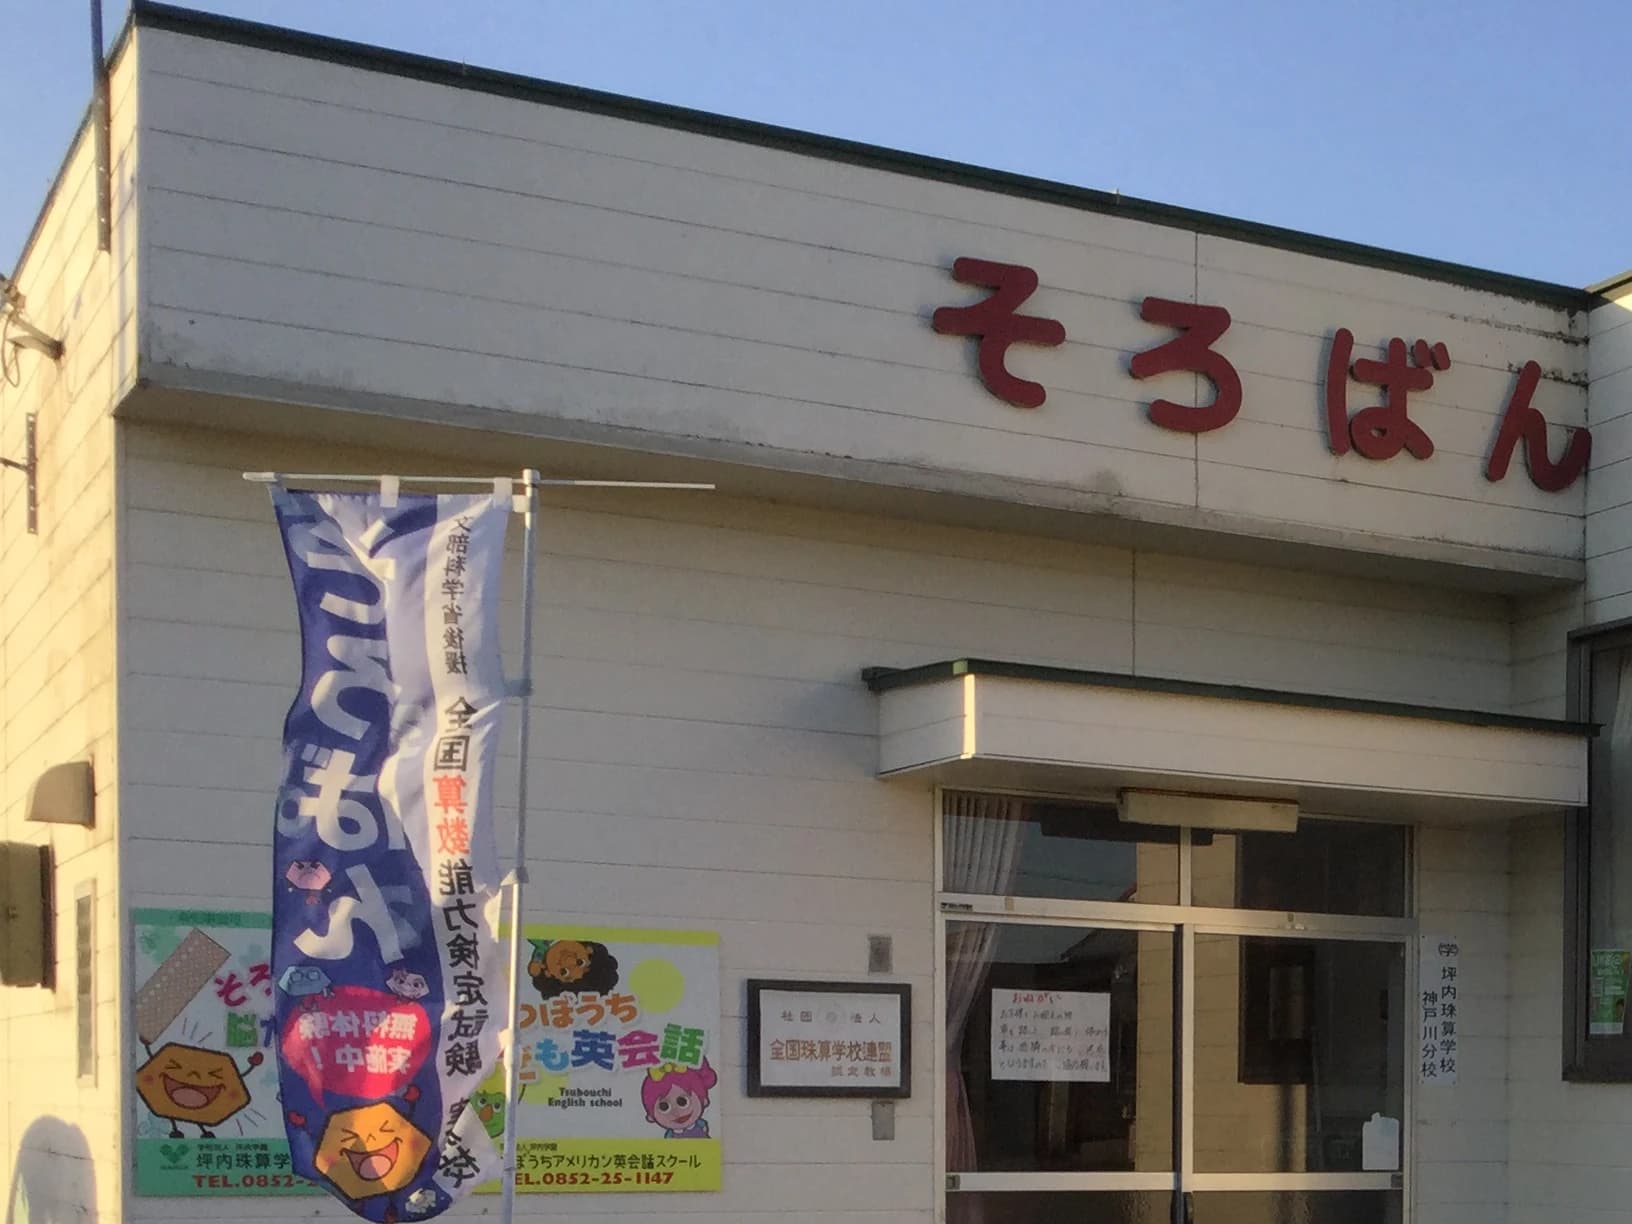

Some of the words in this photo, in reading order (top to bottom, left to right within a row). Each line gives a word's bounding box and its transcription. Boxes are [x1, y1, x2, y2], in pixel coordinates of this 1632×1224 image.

[932, 256, 1592, 492] そろばん
[519, 992, 638, 1029] つぼうち
[1440, 966, 1457, 1073] 坪内珠算学校
[1421, 991, 1438, 1077] 神戸川分校
[769, 1038, 893, 1063] 全国珠算学校連盟
[548, 1097, 586, 1109] English
[589, 1097, 623, 1108] school
[559, 1087, 612, 1097] Tsubouchi
[515, 1150, 703, 1170] ぼうちアメリカン英会話スクール
[515, 1171, 675, 1186] EL.0852-25-1147
